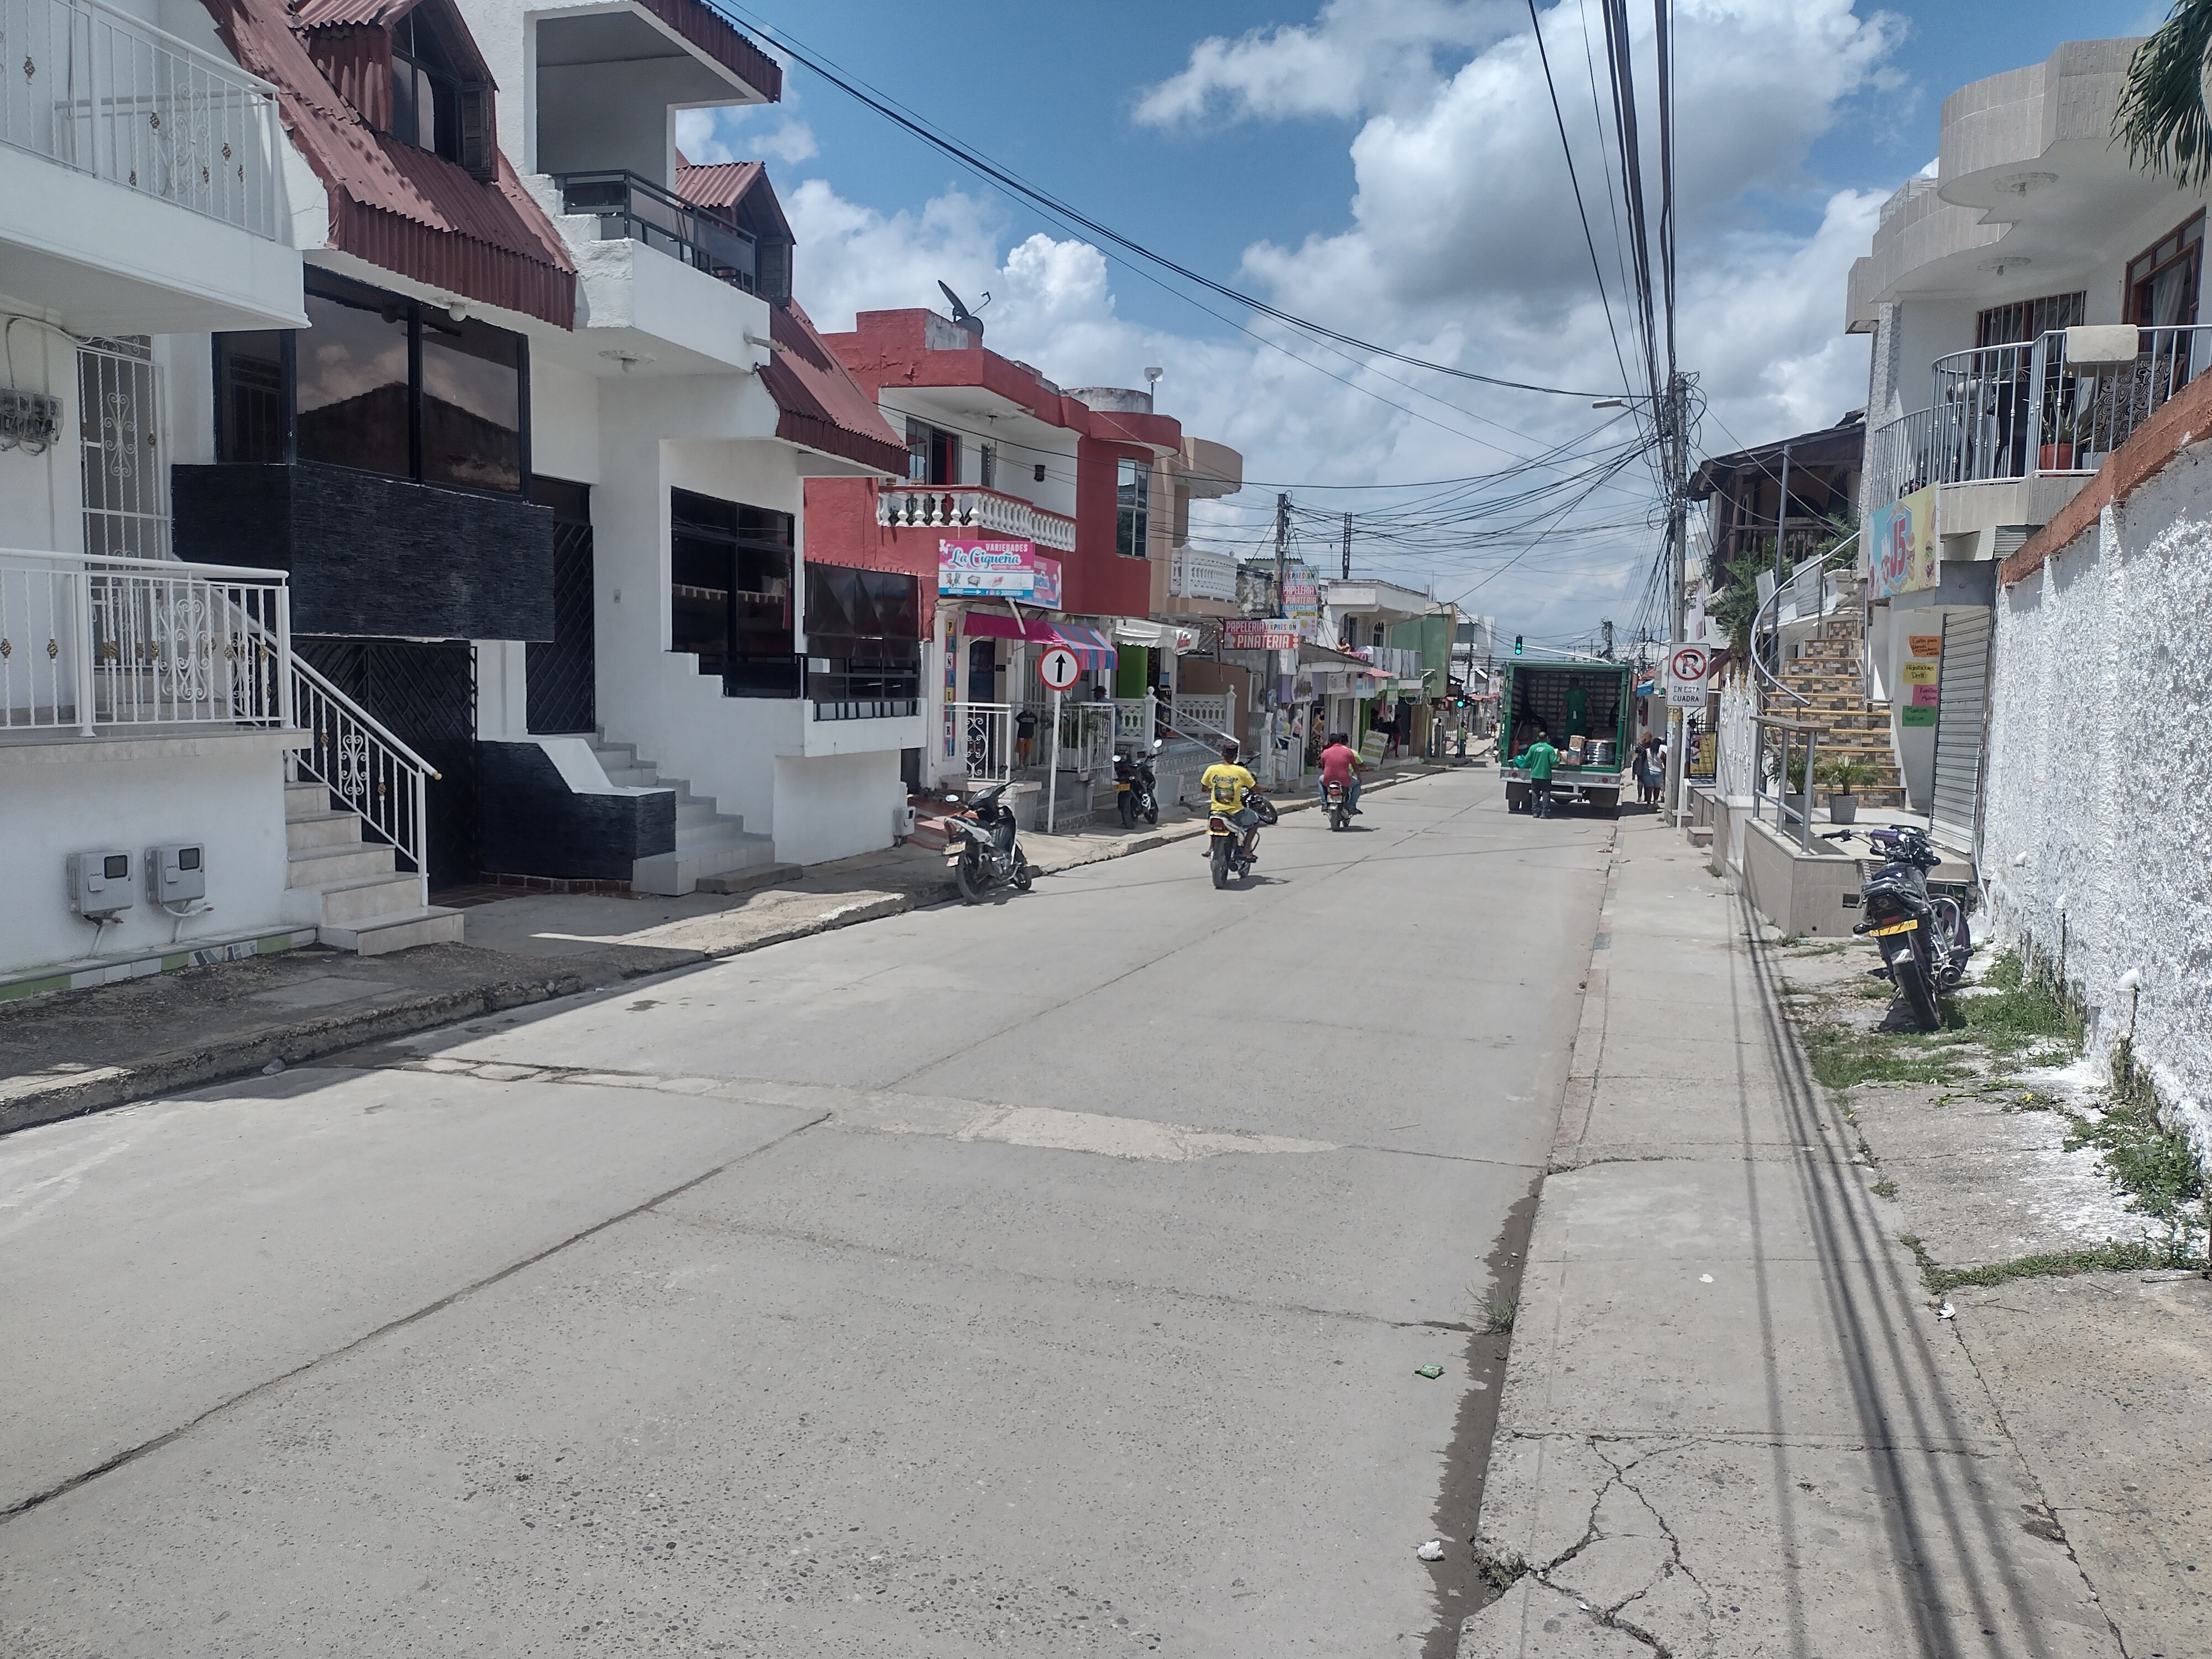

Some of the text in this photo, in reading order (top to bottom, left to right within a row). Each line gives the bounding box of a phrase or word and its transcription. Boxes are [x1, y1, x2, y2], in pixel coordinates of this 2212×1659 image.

[985, 544, 1028, 552] VARIEDADES
[950, 549, 967, 567] La
[1283, 586, 1314, 595] PAPELERIA
[1226, 622, 1264, 633] PAPELERIA
